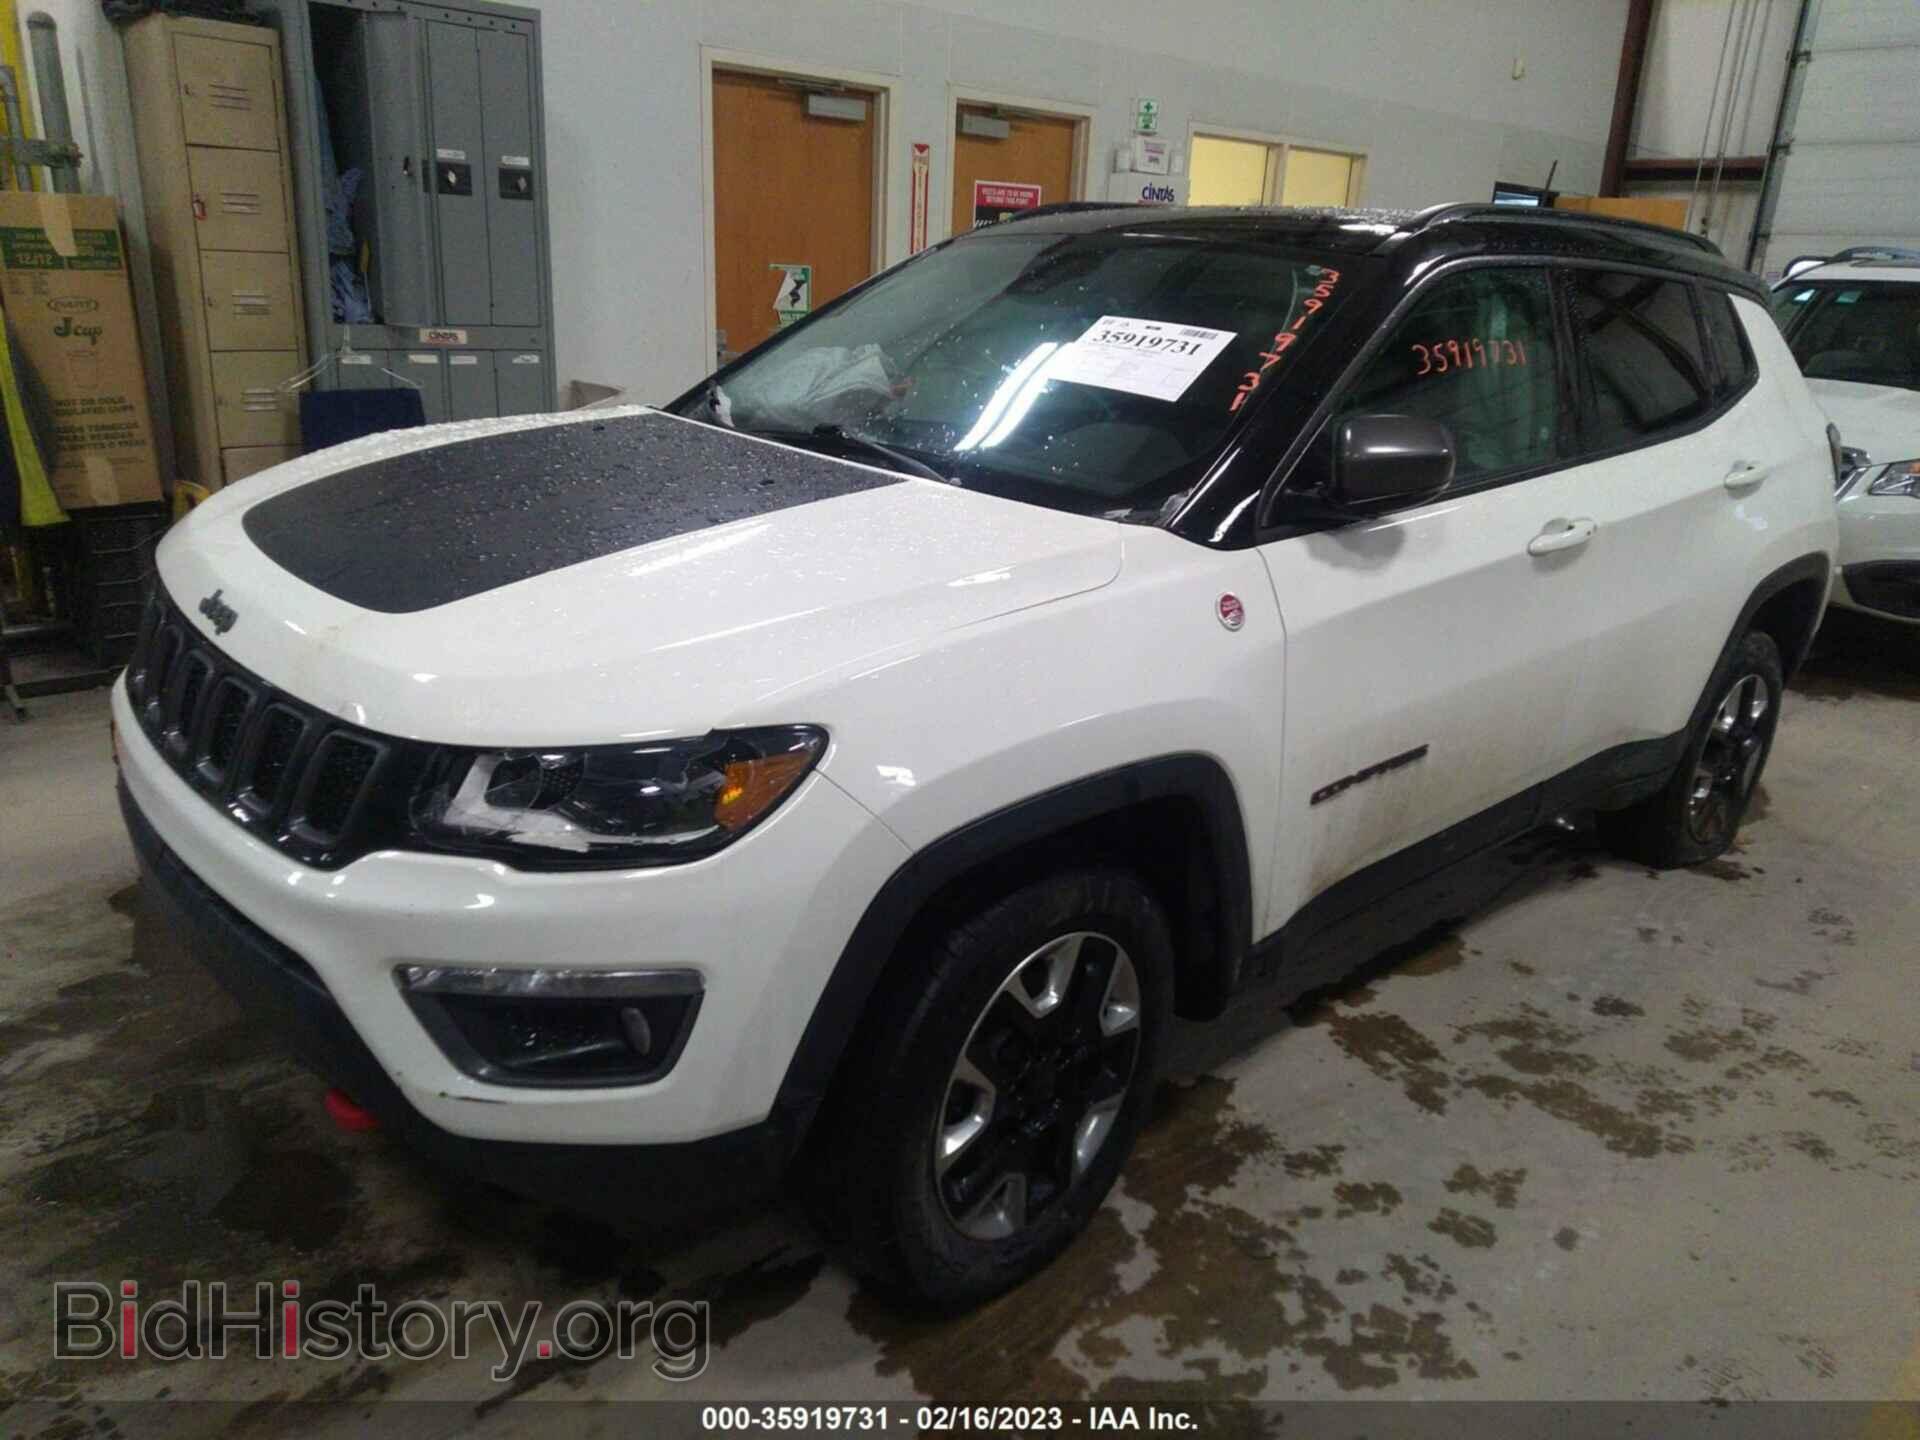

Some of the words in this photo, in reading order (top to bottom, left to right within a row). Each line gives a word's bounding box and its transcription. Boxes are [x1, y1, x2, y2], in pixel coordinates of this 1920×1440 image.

[73, 325, 103, 346] cup
[1093, 330, 1203, 356] 35919731
[1229, 268, 1340, 411] 35919731
[1411, 338, 1527, 375] 35919731
